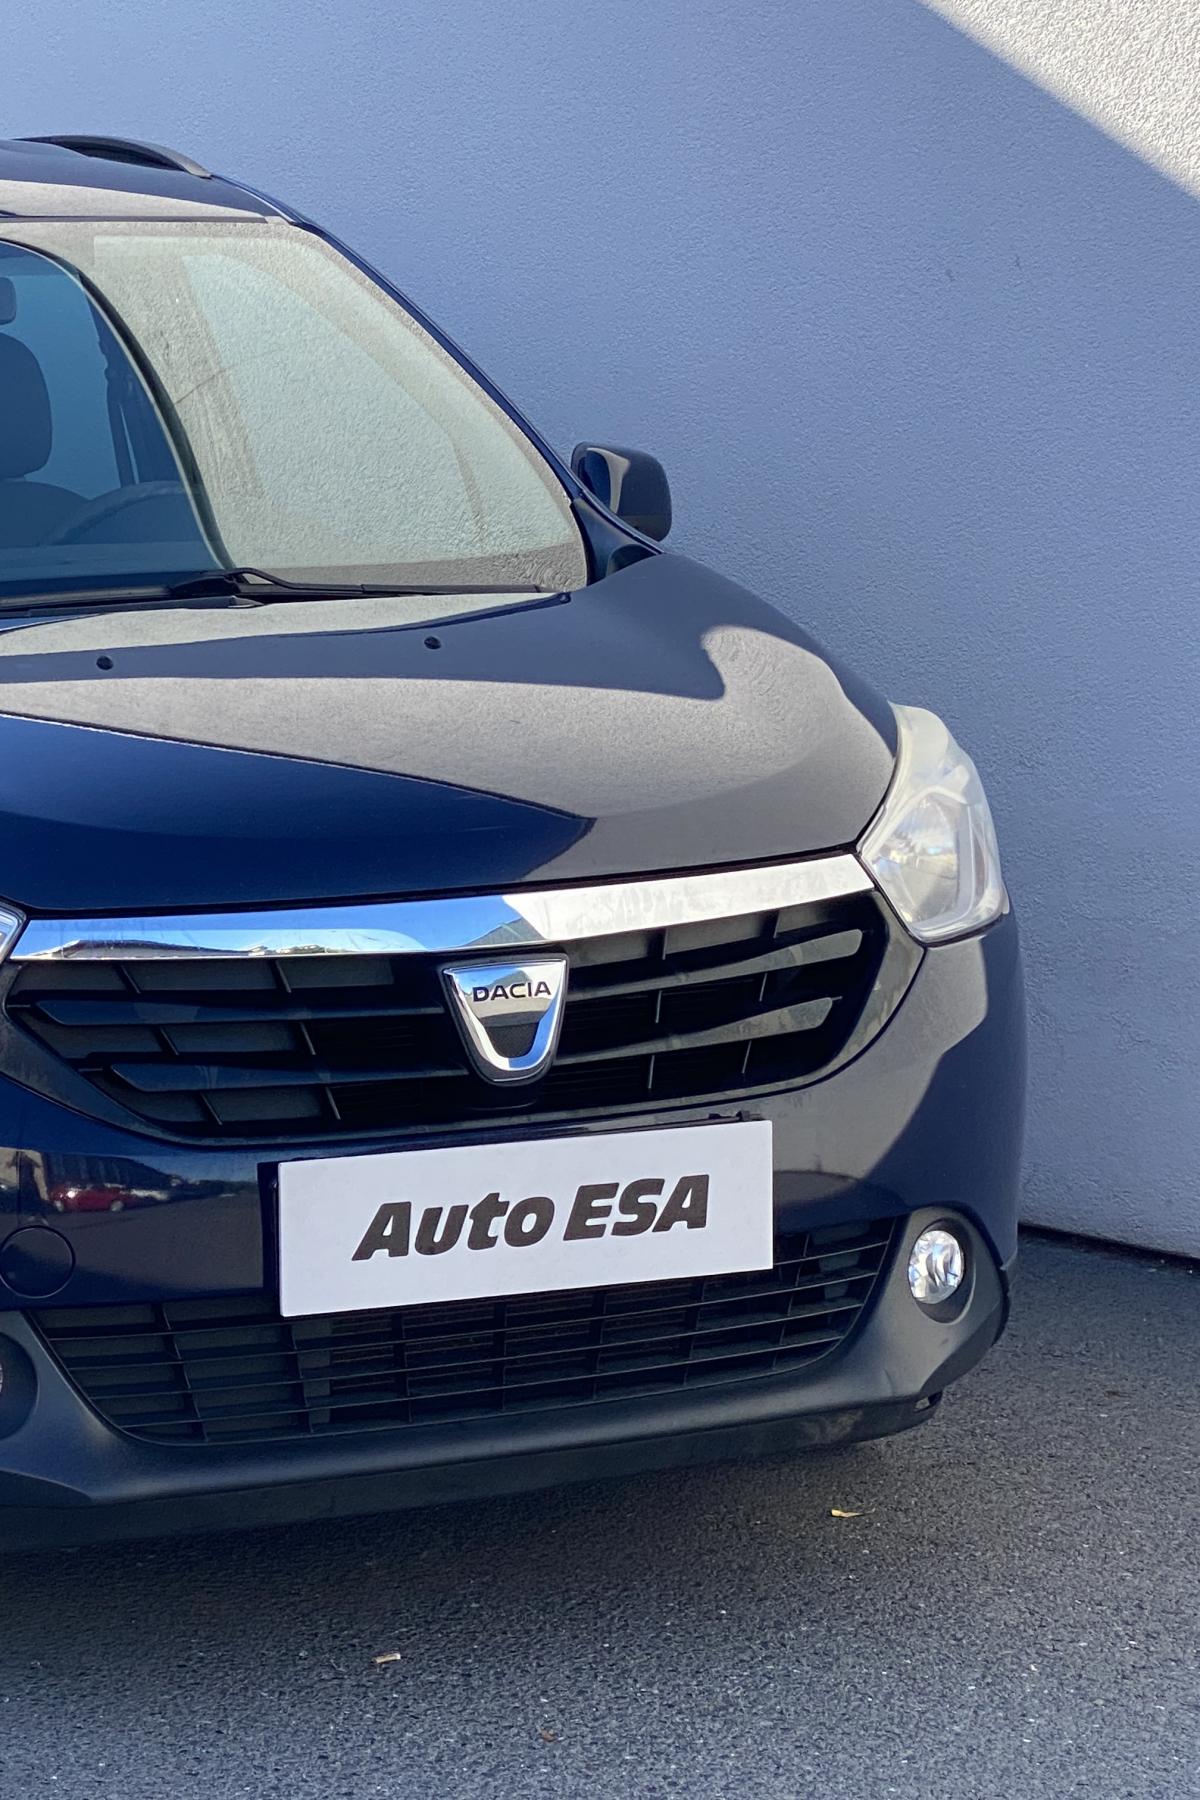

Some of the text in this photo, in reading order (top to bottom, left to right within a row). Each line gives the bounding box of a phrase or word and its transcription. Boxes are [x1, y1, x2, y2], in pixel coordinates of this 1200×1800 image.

[472, 981, 552, 1002] DACIA
[352, 1174, 710, 1261] Auto ESA
